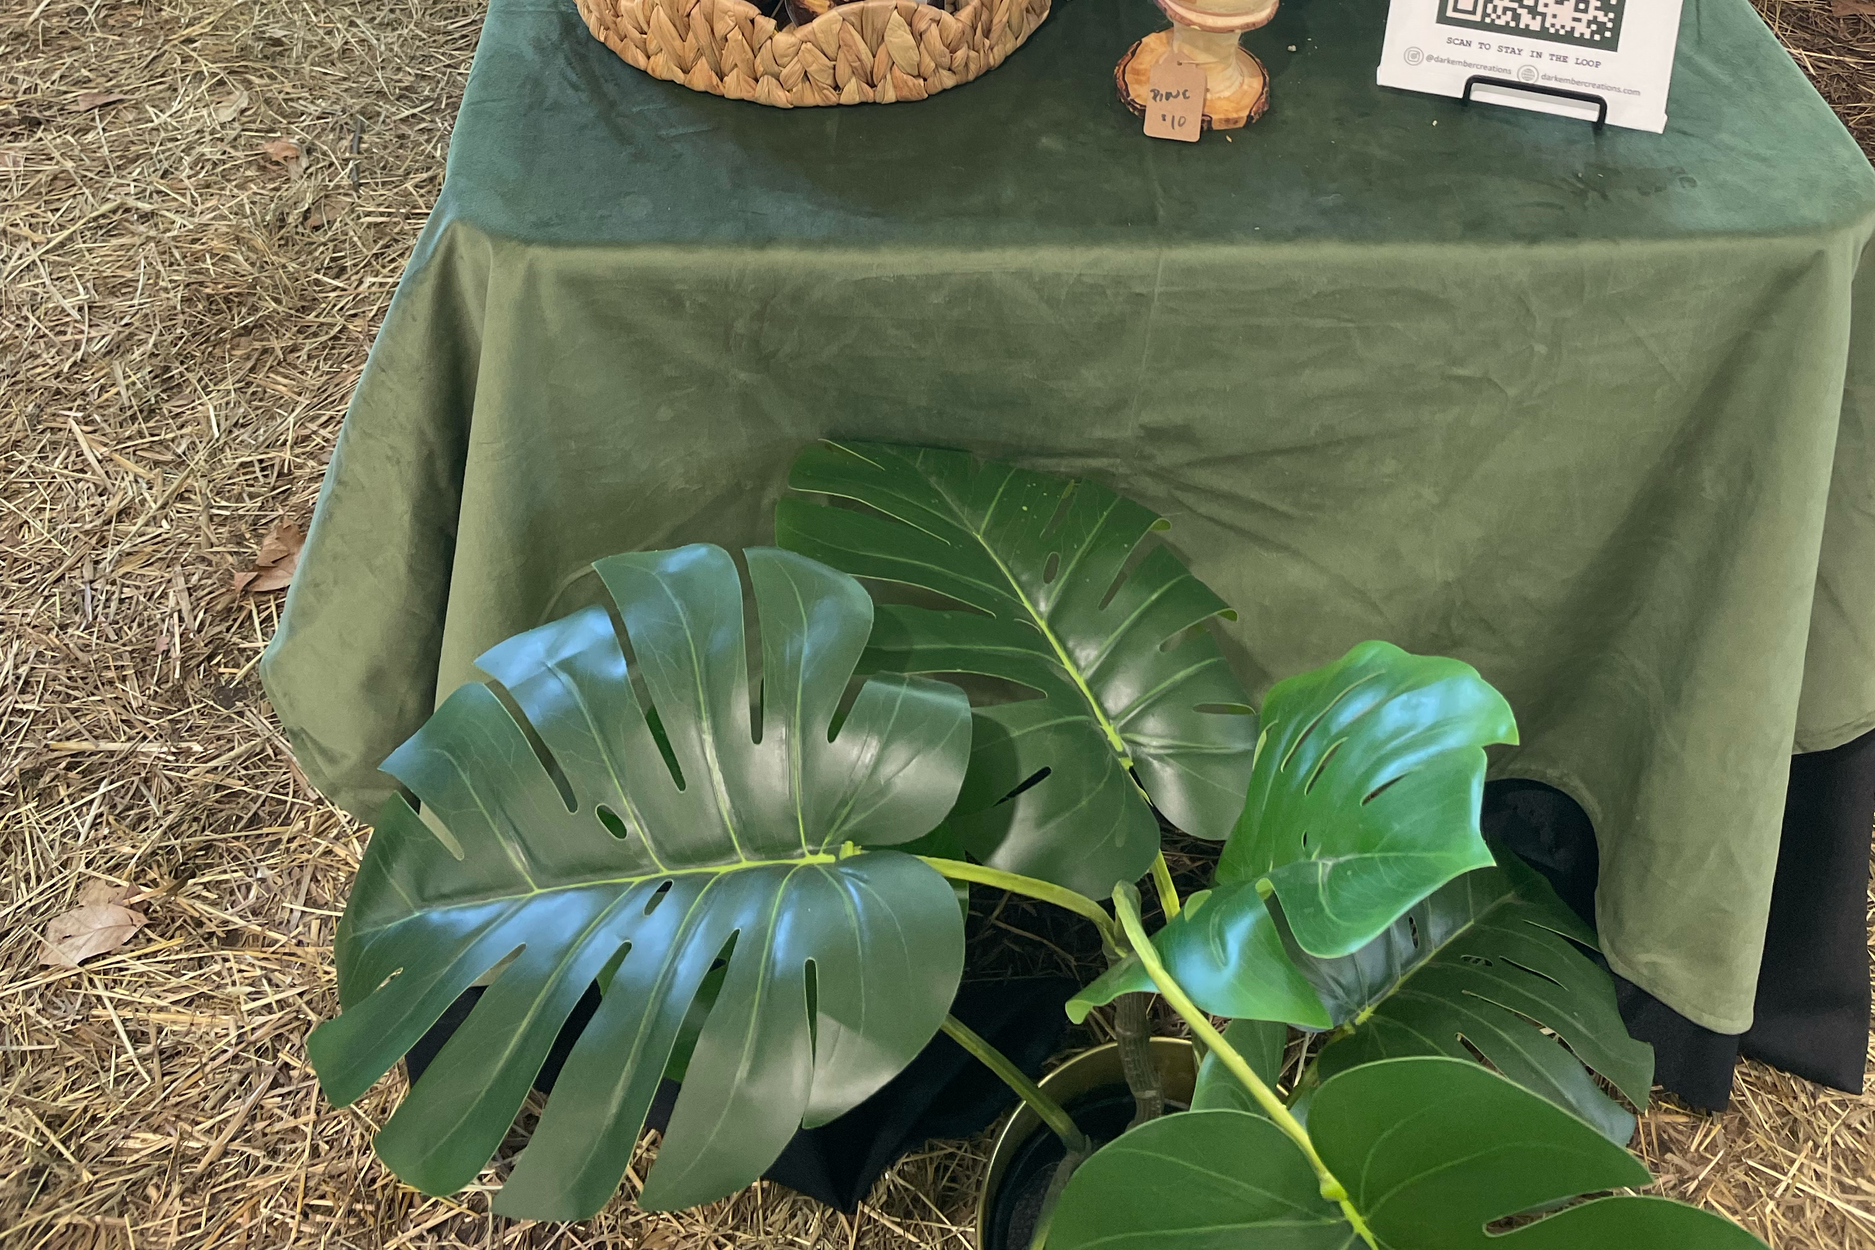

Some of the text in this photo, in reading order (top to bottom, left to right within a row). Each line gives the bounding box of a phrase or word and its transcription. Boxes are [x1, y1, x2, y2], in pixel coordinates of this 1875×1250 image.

[1446, 37, 1602, 68] SCAN TO STAY IN THE LOOP
[1425, 54, 1512, 75] @darkembercreations
[1150, 88, 1190, 102] PINE
[1541, 73, 1641, 96] darkembercreations.com
[1161, 113, 1187, 130] $10
